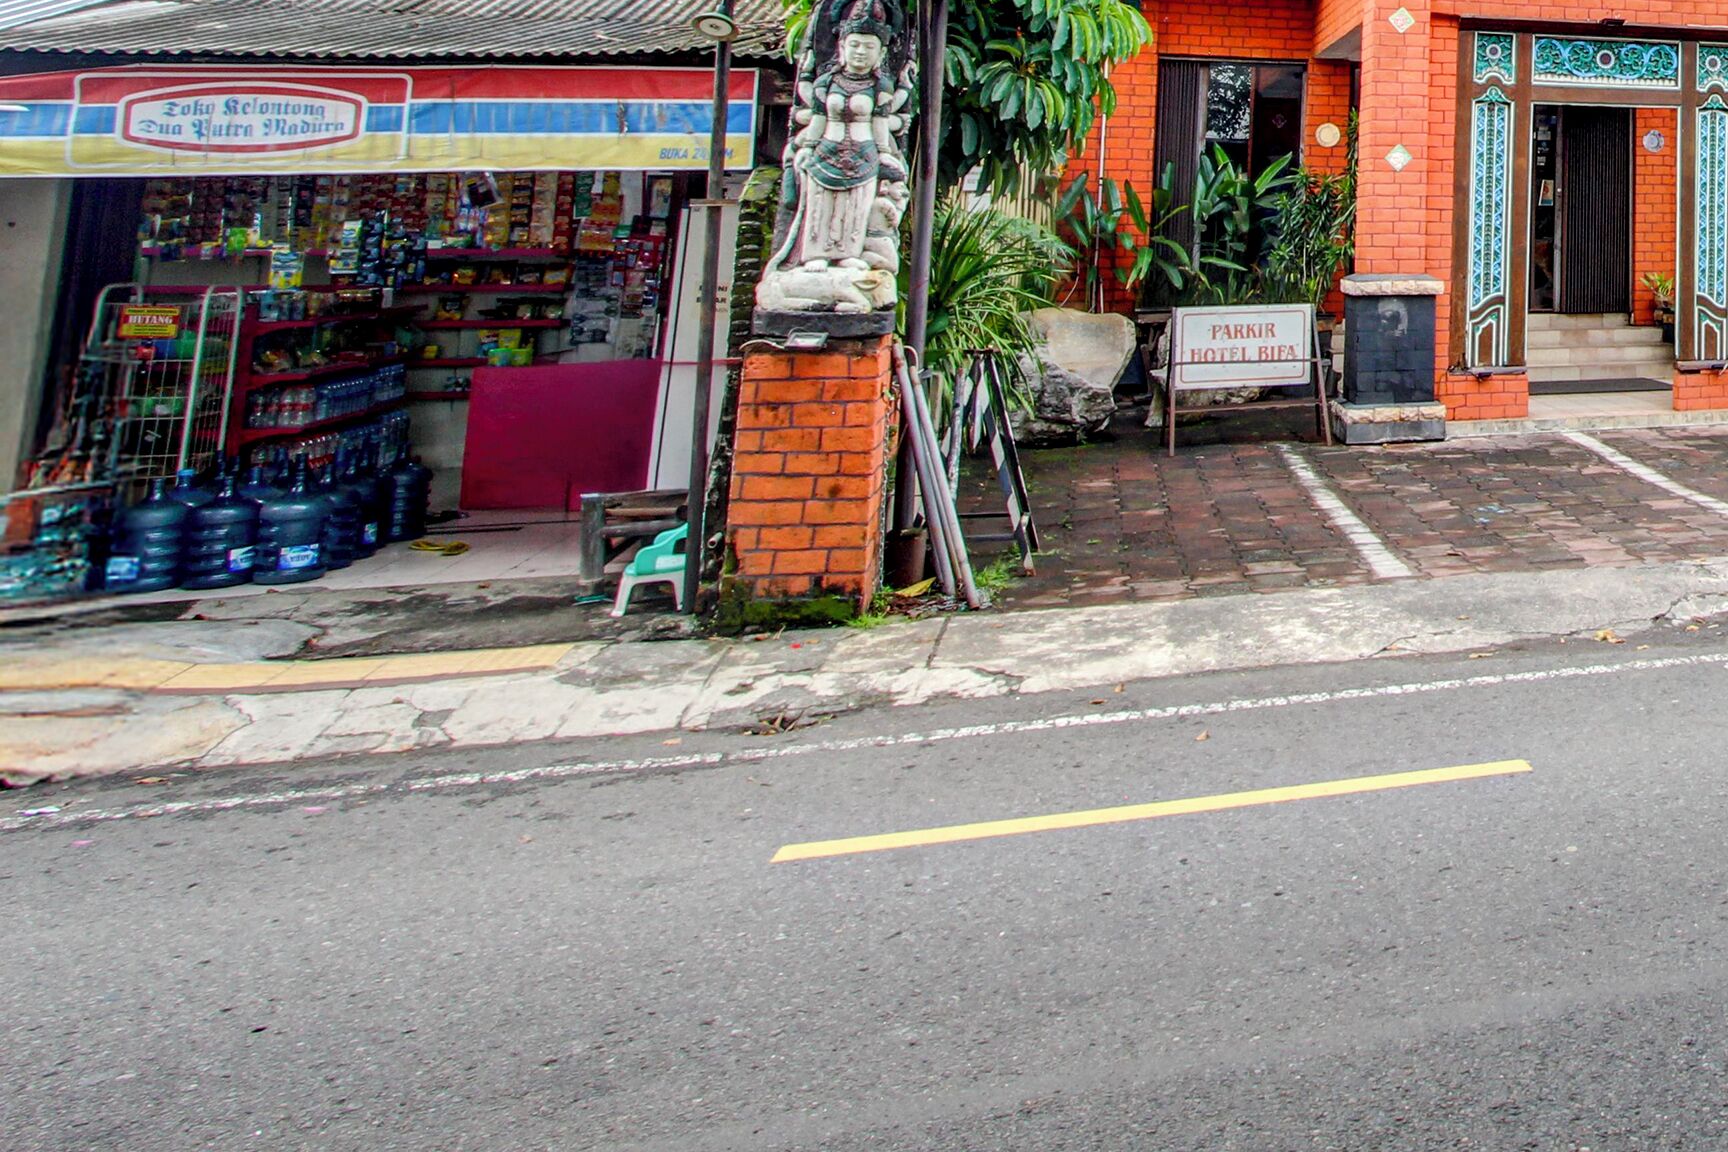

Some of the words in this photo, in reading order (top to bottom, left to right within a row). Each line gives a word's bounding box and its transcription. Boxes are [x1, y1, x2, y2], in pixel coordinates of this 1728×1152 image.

[162, 98, 215, 117] Toko
[223, 97, 326, 120] Kelontong
[139, 119, 182, 136] Dua
[193, 118, 253, 139] Putra
[262, 118, 345, 137] Madura
[659, 148, 688, 159] BUKA
[1211, 323, 1276, 340] PARKIR
[1190, 346, 1251, 362] HOTEL
[1258, 344, 1298, 361] BIFA
